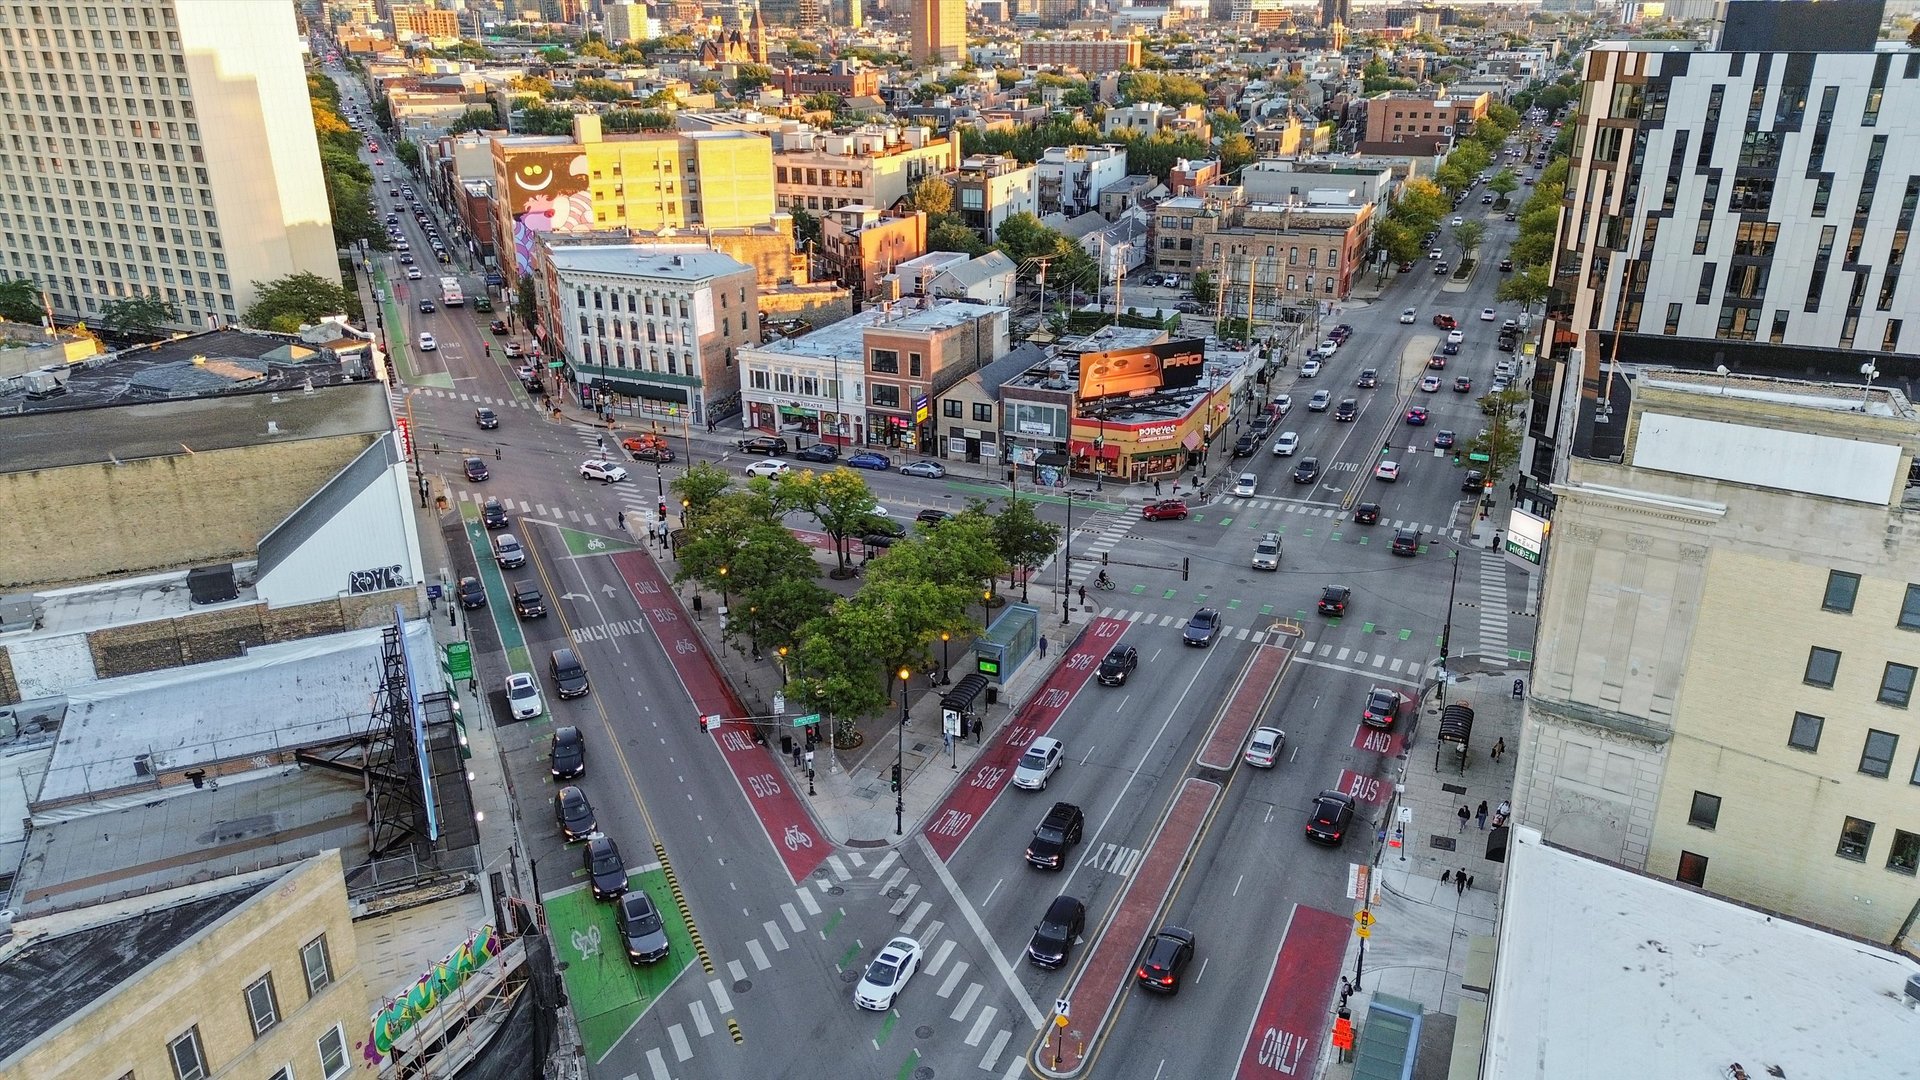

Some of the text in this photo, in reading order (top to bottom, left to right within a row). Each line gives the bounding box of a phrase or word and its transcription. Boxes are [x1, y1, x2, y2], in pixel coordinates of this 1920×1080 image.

[1163, 354, 1202, 369] PRO
[1330, 461, 1359, 472] ONLY
[635, 580, 661, 595] ONLY
[652, 608, 678, 623] BUS
[572, 624, 608, 644] ONLY
[609, 618, 645, 637] ONLY
[1094, 621, 1120, 638] CTA
[1067, 653, 1094, 671] BUS
[1034, 688, 1070, 708] ONLY
[722, 729, 756, 752] ONLY
[1006, 726, 1037, 747] CTA
[1363, 731, 1391, 753] AND
[748, 773, 781, 799] BUS
[971, 765, 1007, 790] BUS
[1350, 775, 1380, 802] BUS
[928, 809, 972, 837] ONLY
[1085, 842, 1141, 876] ONLY
[1258, 1027, 1309, 1076] ONLY
